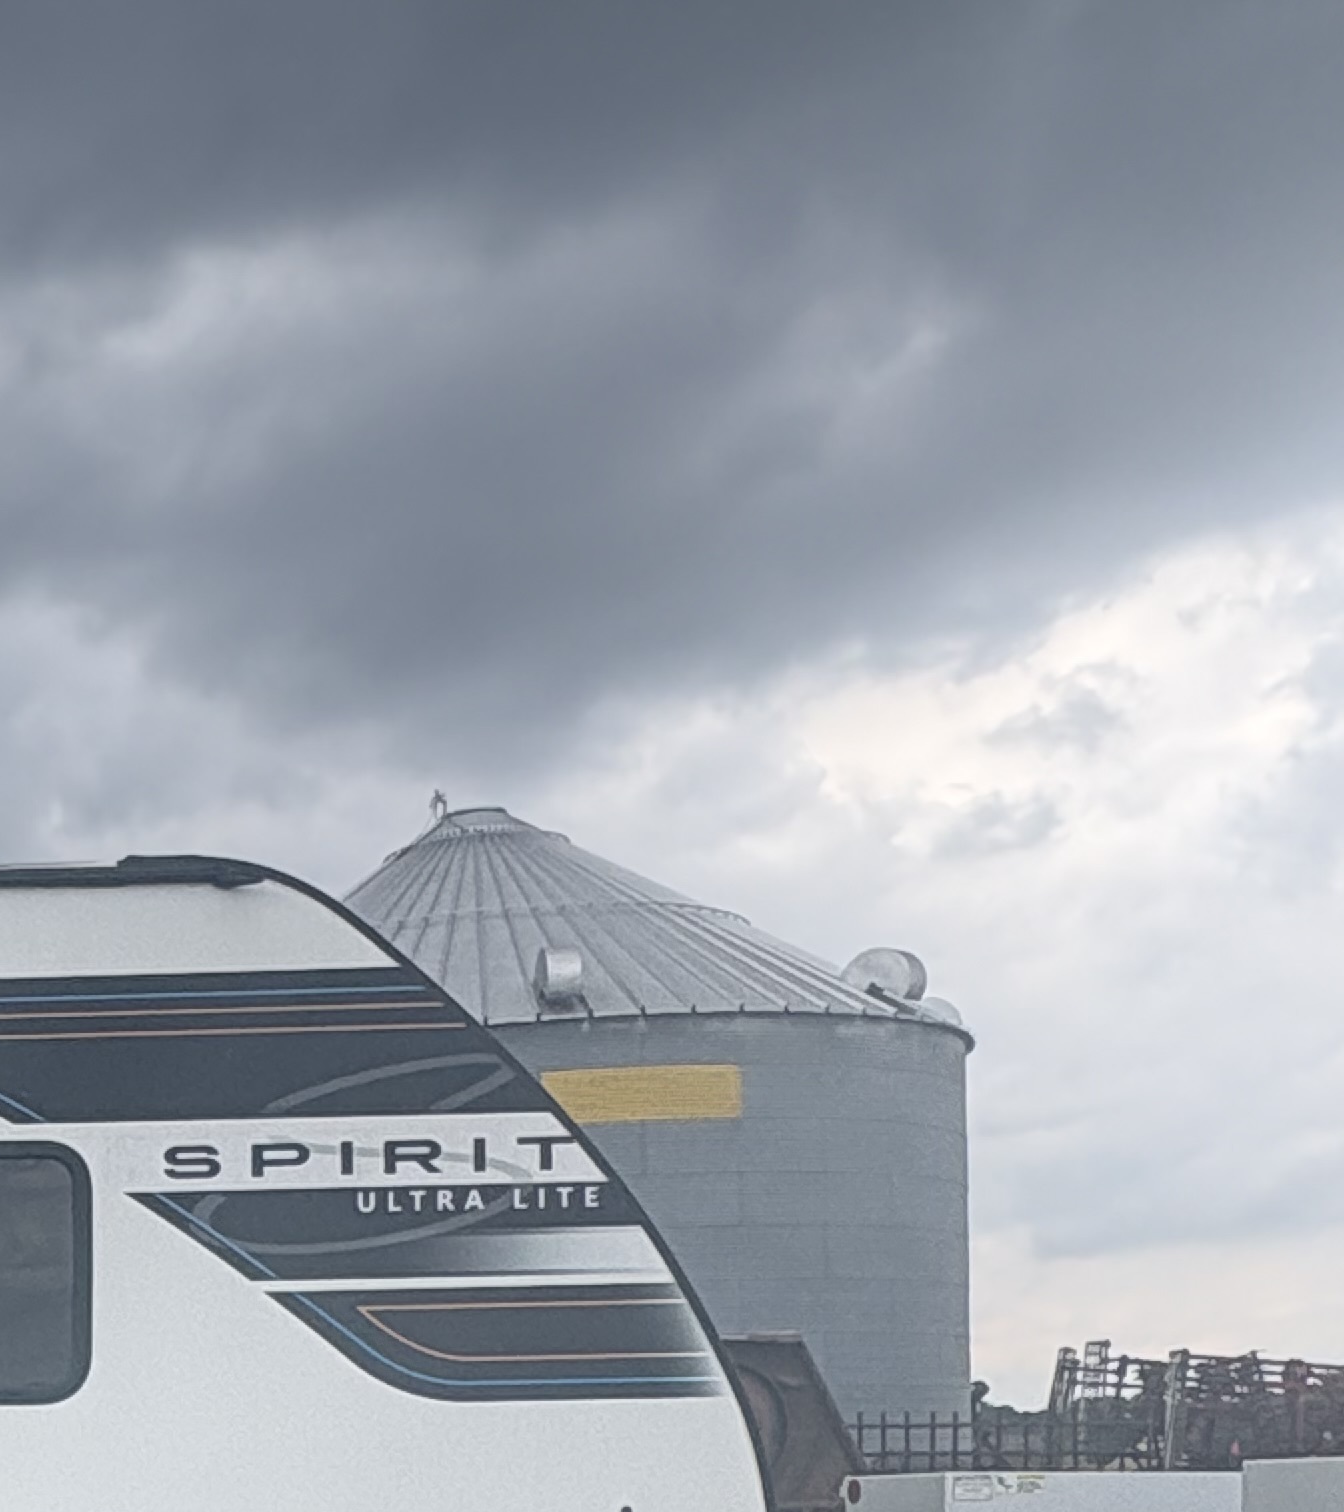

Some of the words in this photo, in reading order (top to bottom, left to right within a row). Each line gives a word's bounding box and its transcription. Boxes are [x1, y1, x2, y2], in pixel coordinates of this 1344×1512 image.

[163, 1137, 576, 1180] SPIRIT
[357, 1190, 486, 1213] ULTRA
[512, 1187, 600, 1210] LITE
